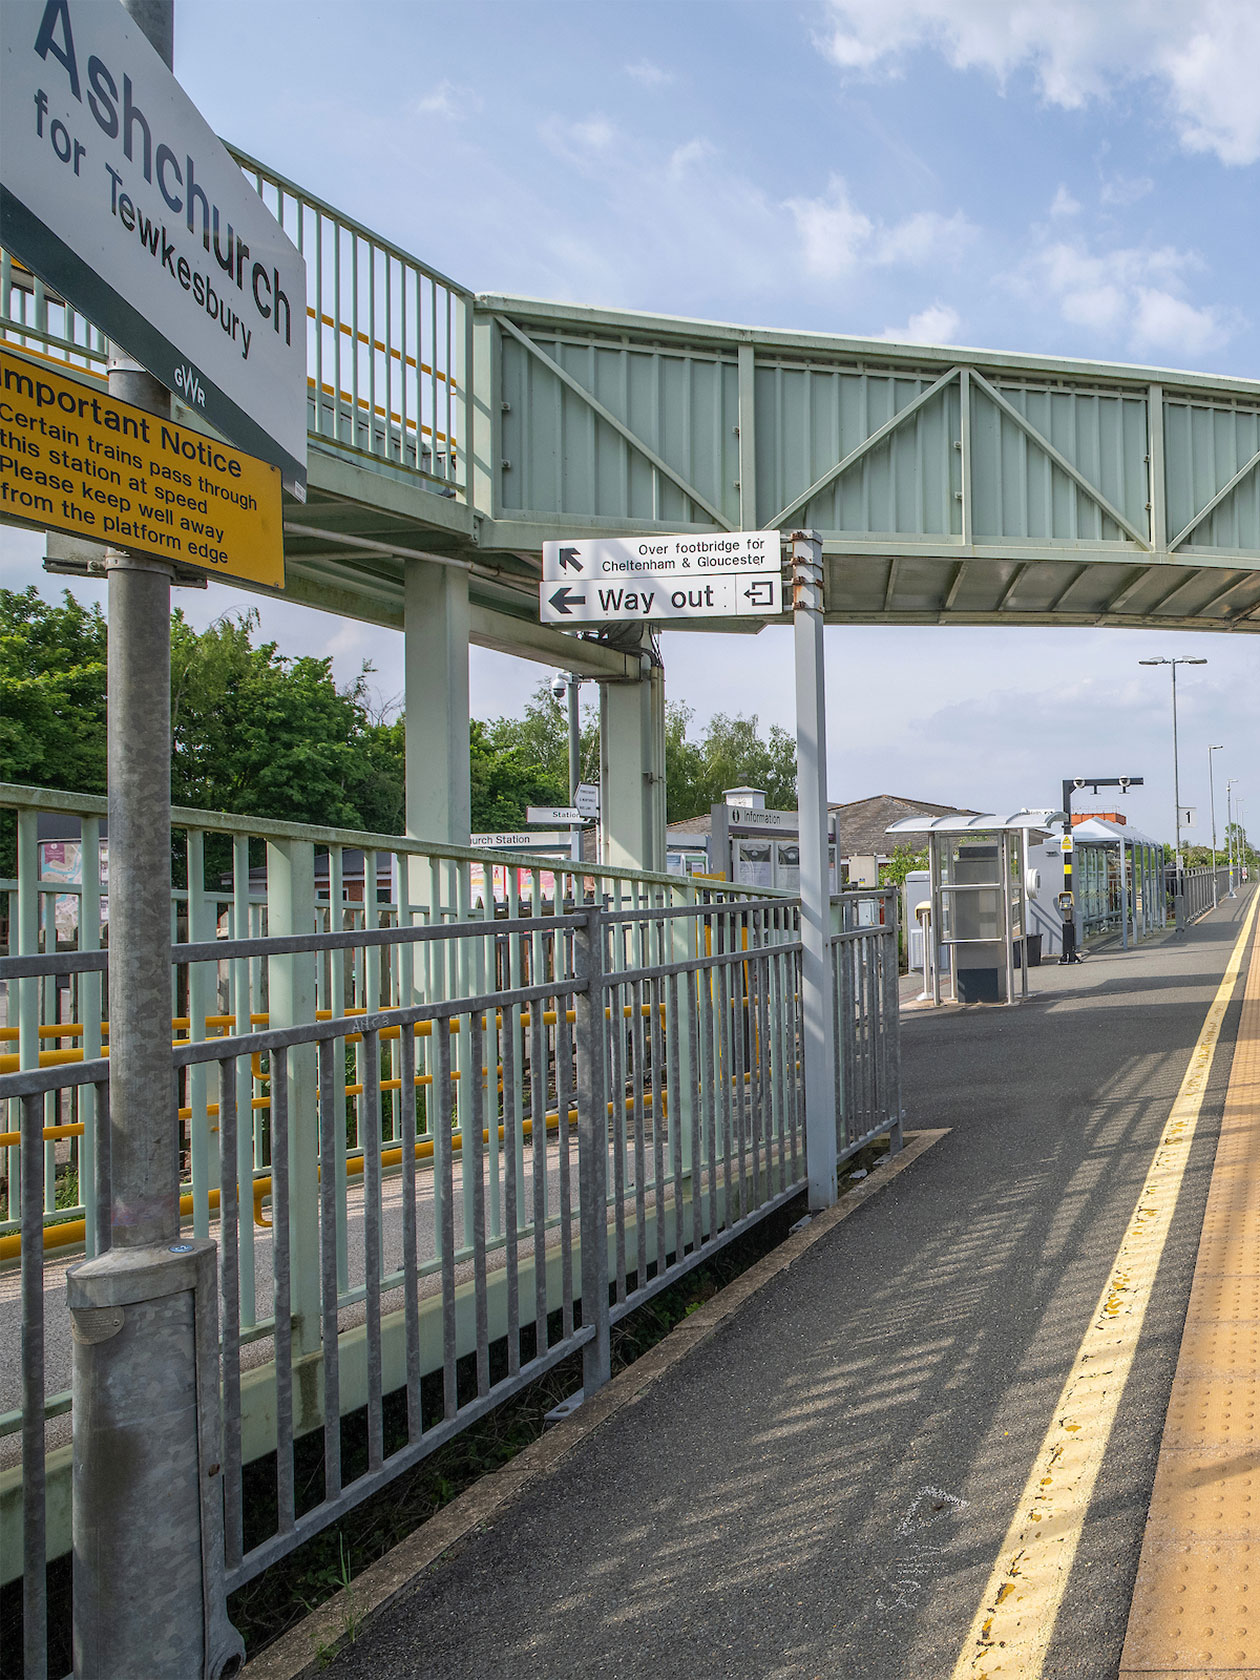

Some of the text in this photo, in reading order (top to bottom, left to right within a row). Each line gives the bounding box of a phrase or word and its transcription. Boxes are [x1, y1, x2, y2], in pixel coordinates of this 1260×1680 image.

[34, 0, 291, 347] Ashchurch
[34, 88, 252, 360] for Tewkesbury
[174, 364, 206, 408] GWR
[0, 403, 79, 447] Certain
[87, 435, 143, 469] trains
[150, 461, 192, 487] pass
[198, 476, 257, 511] through
[0, 428, 207, 514] this station at speed
[161, 425, 242, 478] Notice
[0, 456, 224, 544] Please keep well away
[1, 482, 228, 564] from the platform edge
[602, 554, 765, 572] Cheltenham & Gloucester
[638, 538, 765, 556] Over footbridge for
[598, 585, 714, 614] Way out
[471, 835, 530, 845] urch Station
[743, 810, 781, 825] Information
[1185, 810, 1191, 824] 1
